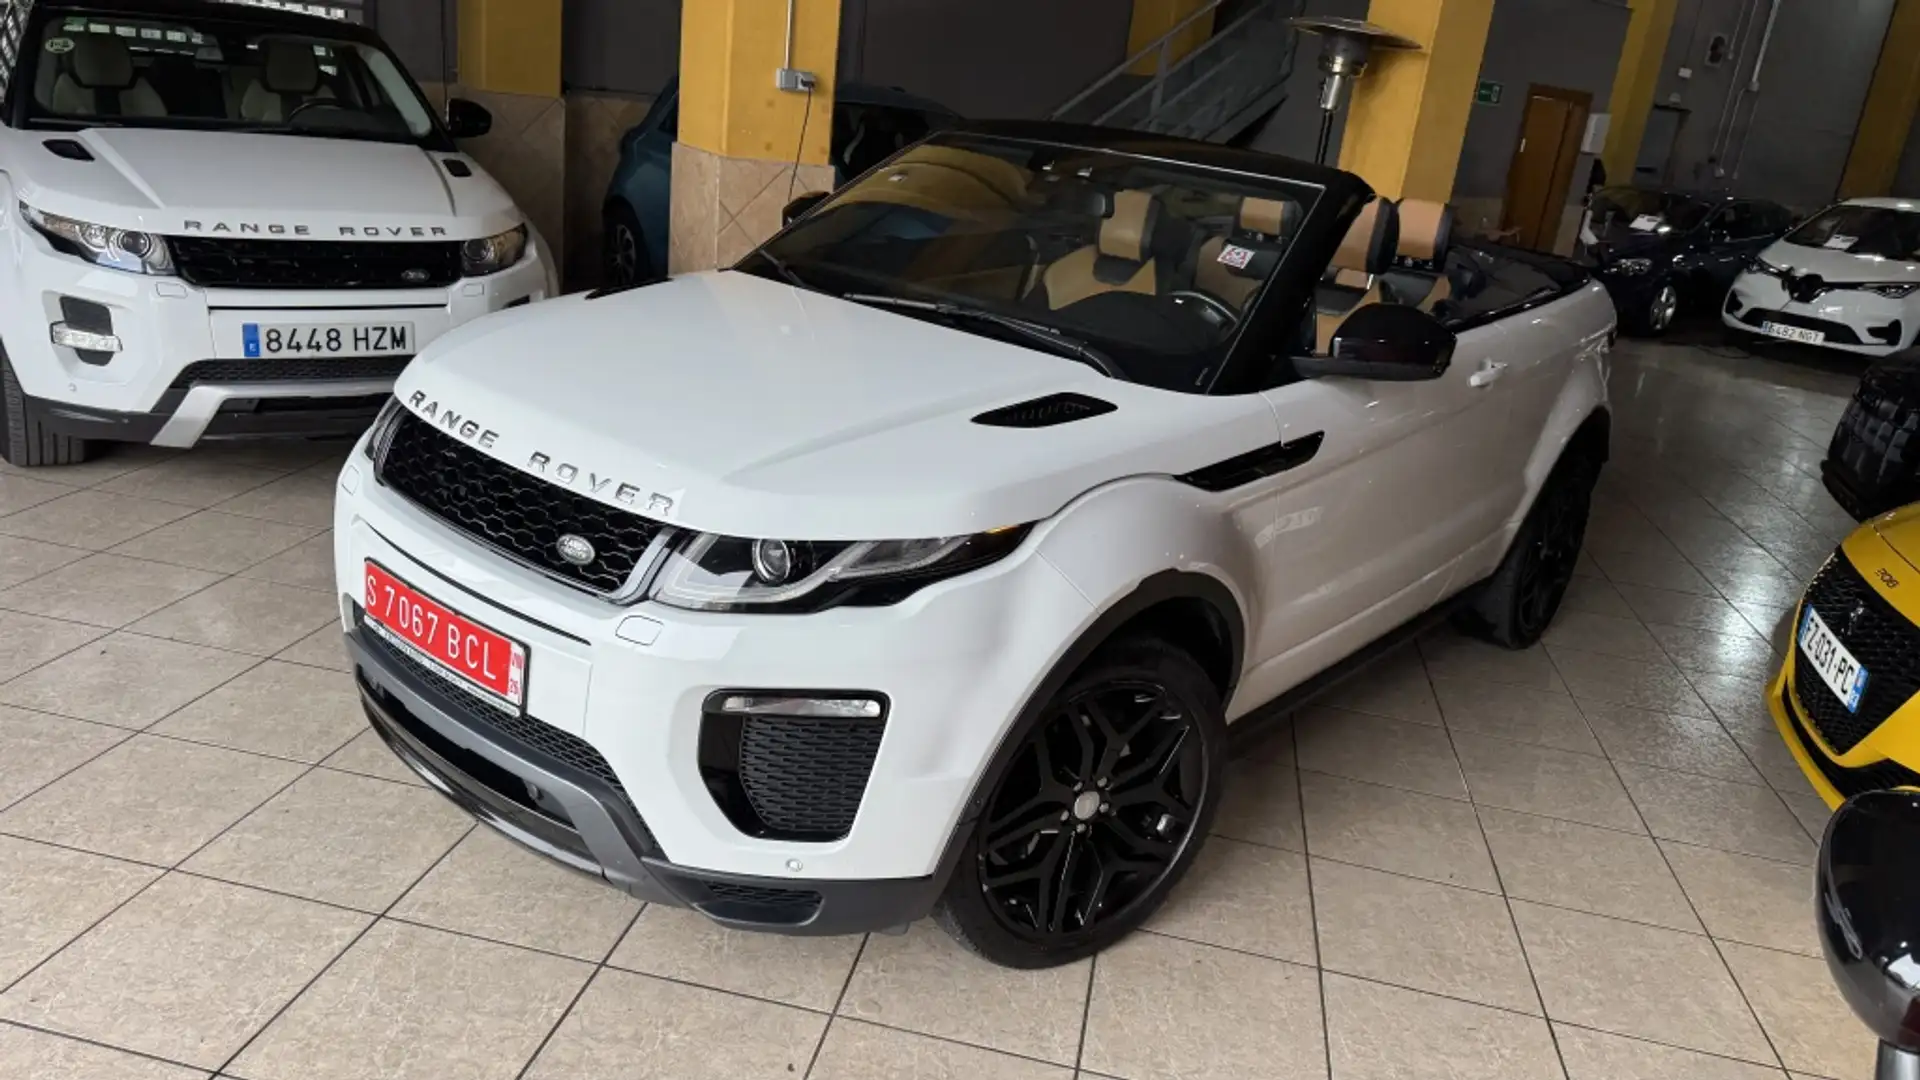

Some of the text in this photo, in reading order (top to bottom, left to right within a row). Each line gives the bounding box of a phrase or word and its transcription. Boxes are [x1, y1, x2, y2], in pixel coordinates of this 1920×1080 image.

[184, 220, 447, 237] RANGE ROVER
[266, 326, 406, 353] 8448 HZM
[409, 390, 674, 516] RANGE ROVER
[367, 575, 376, 607] S
[384, 584, 439, 645] 7067
[447, 623, 497, 681] BCL
